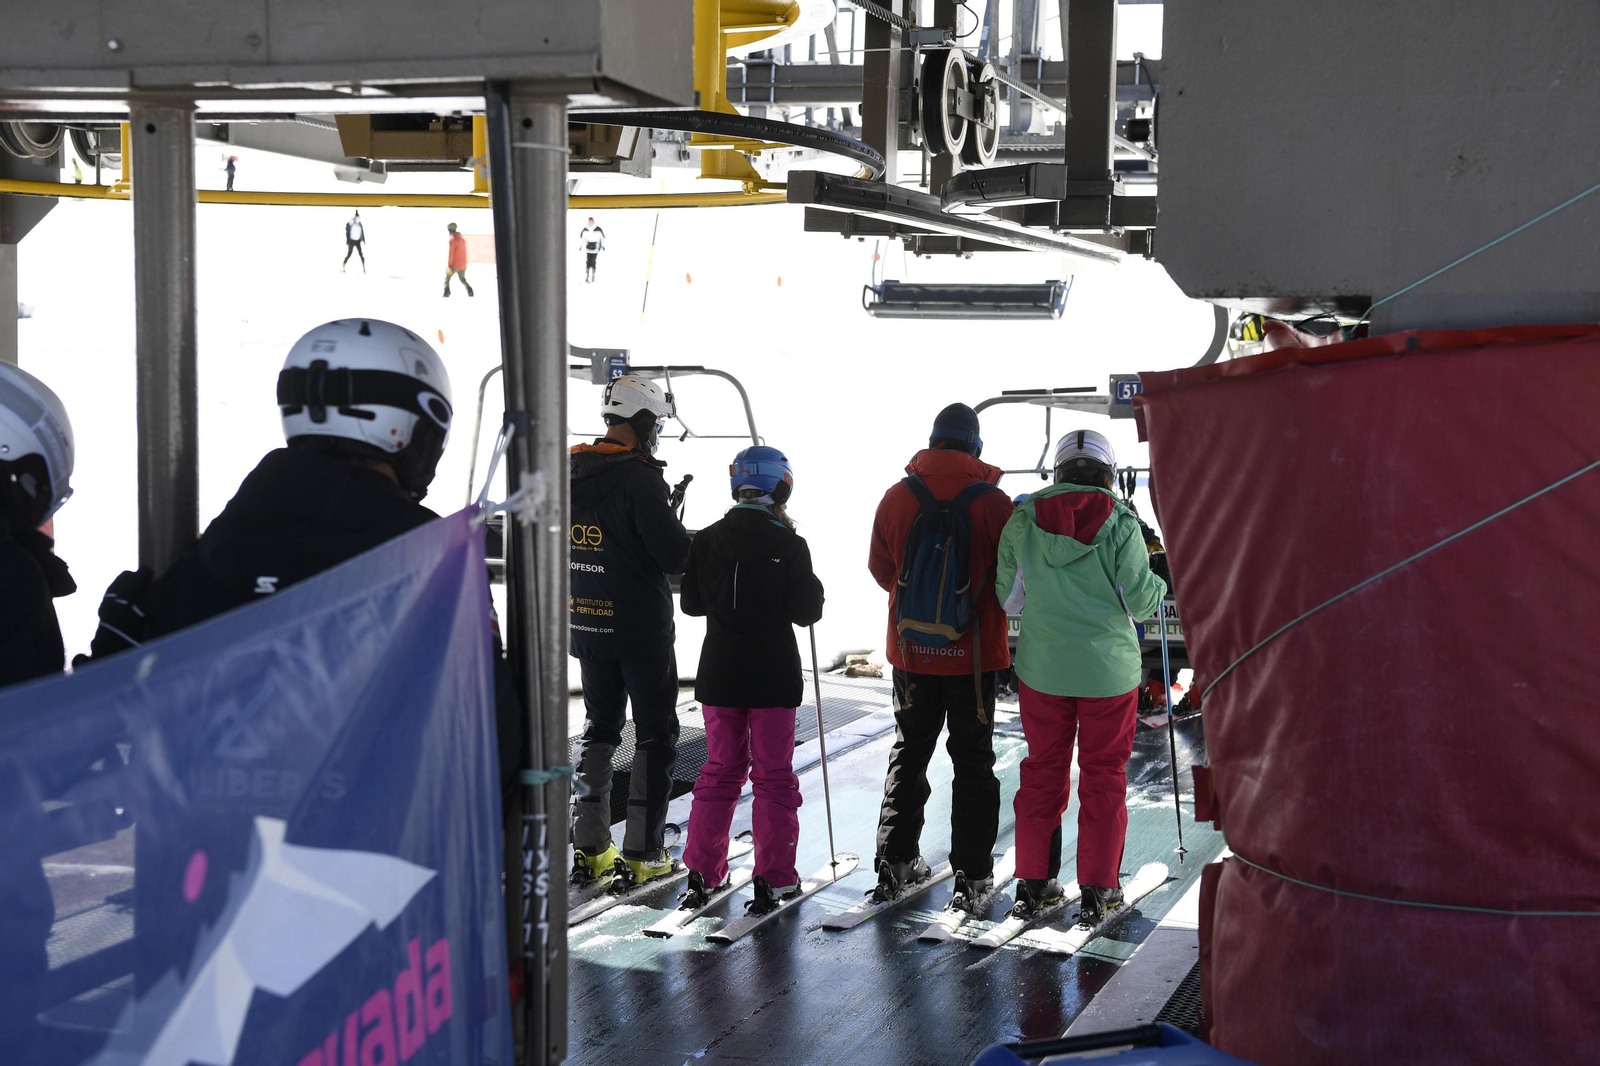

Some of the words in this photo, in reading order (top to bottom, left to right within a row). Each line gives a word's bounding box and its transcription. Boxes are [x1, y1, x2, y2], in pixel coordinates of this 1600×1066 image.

[1123, 384, 1137, 398] 51
[568, 562, 605, 573] ROFESOR
[577, 598, 603, 606] INSTITUTO
[604, 600, 613, 608] DE
[576, 606, 614, 617] FERTILIDAD
[297, 936, 454, 1066] vada
